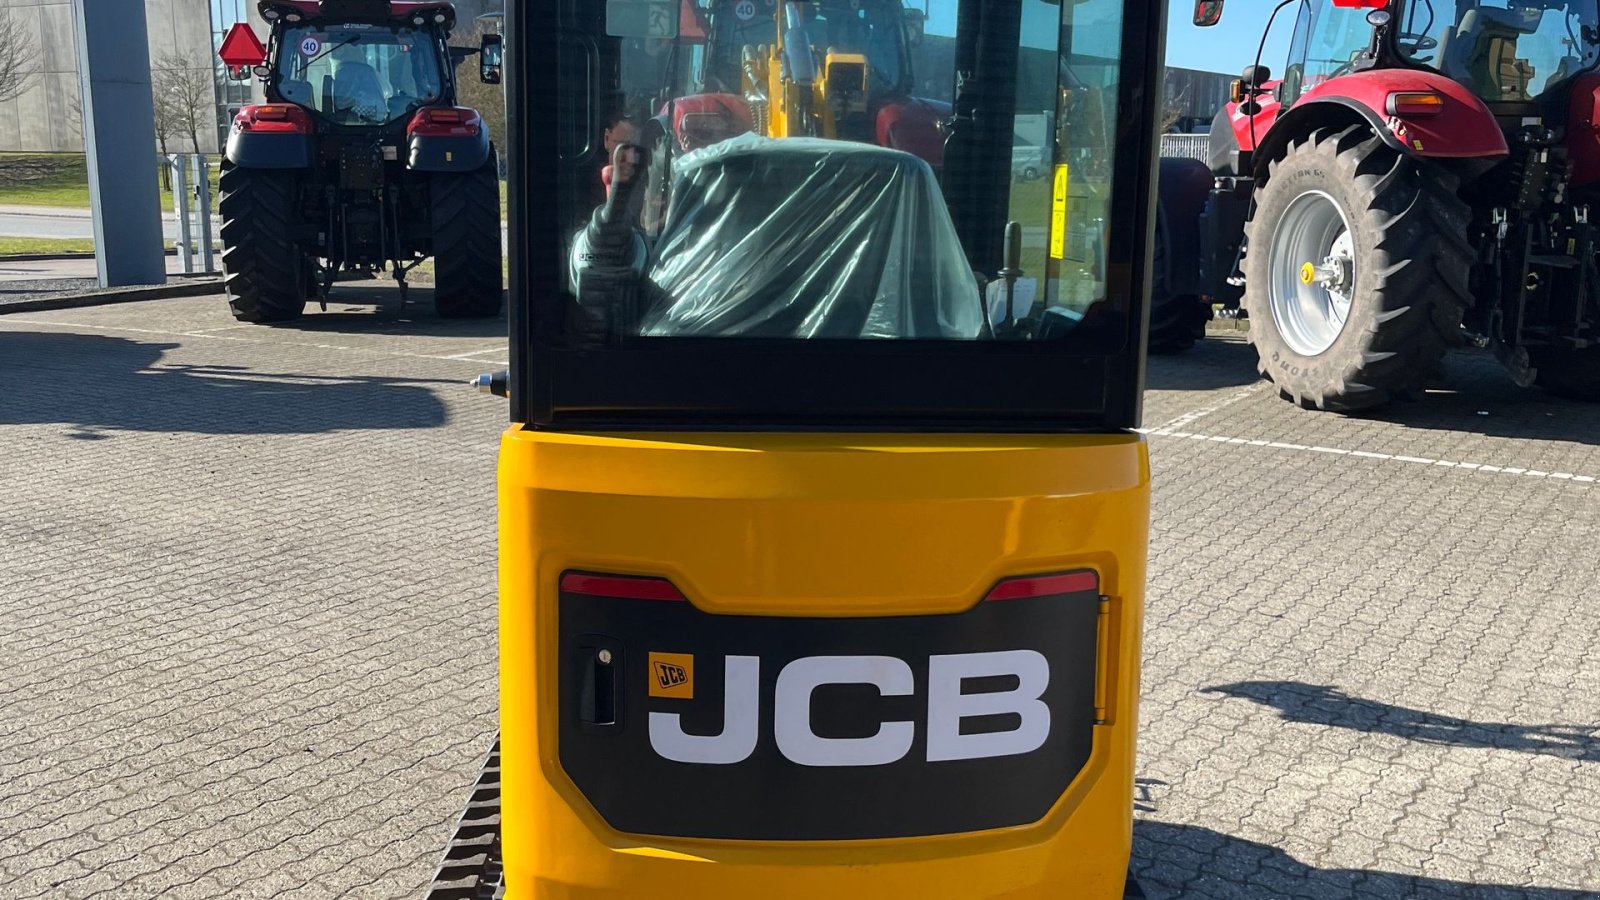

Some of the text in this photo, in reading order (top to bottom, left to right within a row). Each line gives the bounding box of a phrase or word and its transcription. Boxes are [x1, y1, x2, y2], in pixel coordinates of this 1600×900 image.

[736, 4, 754, 16] 40
[303, 42, 317, 52] 40
[660, 664, 686, 686] JCB
[648, 649, 1051, 767] JCB
